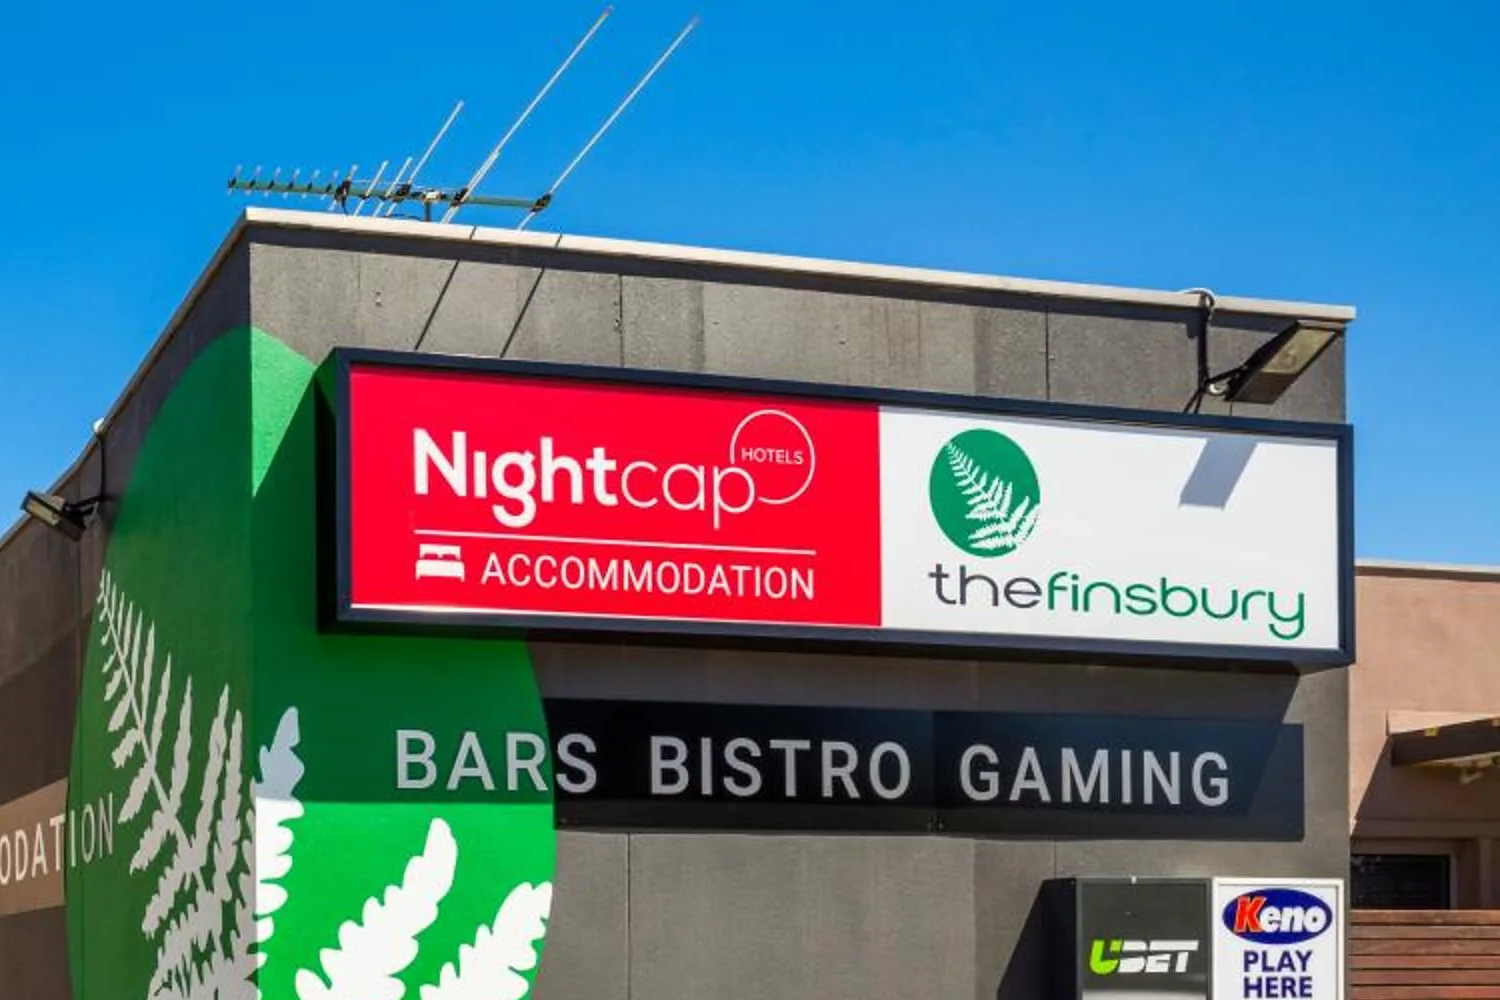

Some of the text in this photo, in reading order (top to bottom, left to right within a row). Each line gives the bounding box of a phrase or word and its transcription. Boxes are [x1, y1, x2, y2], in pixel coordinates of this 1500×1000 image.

[741, 447, 804, 466] HOTELS
[413, 427, 755, 530] Nightcap
[480, 552, 816, 600] ACCOMMODATION
[395, 729, 1230, 807] BARS BISTRO GAMING
[1233, 895, 1328, 934] Keno
[1089, 939, 1200, 976] UBET
[1242, 950, 1313, 972] PLAY
[1242, 977, 1313, 998] HERE
